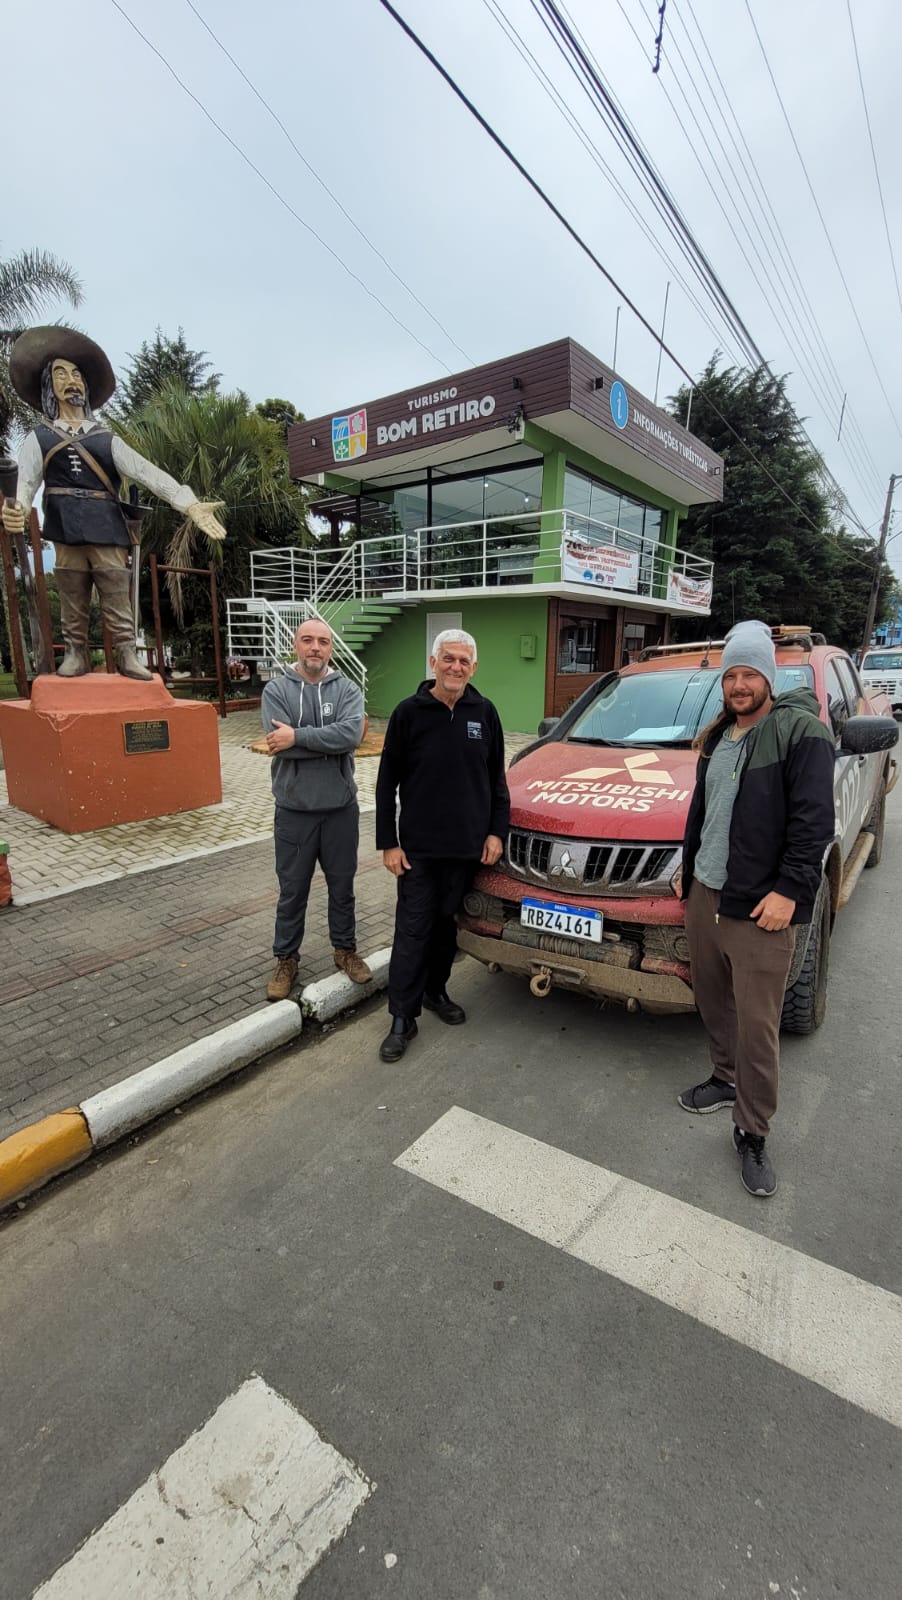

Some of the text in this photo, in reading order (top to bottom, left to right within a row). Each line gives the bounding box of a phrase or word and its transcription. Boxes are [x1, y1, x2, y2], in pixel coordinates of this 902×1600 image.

[407, 387, 458, 411] TURISMO
[376, 395, 496, 446] BOM RETIRO
[633, 408, 709, 473] INFORMAÇÕES TURÍSTICAS
[526, 780, 691, 802] MITSUBISHI
[531, 791, 655, 813] MOTORS
[527, 908, 592, 937] RBZ4I61
